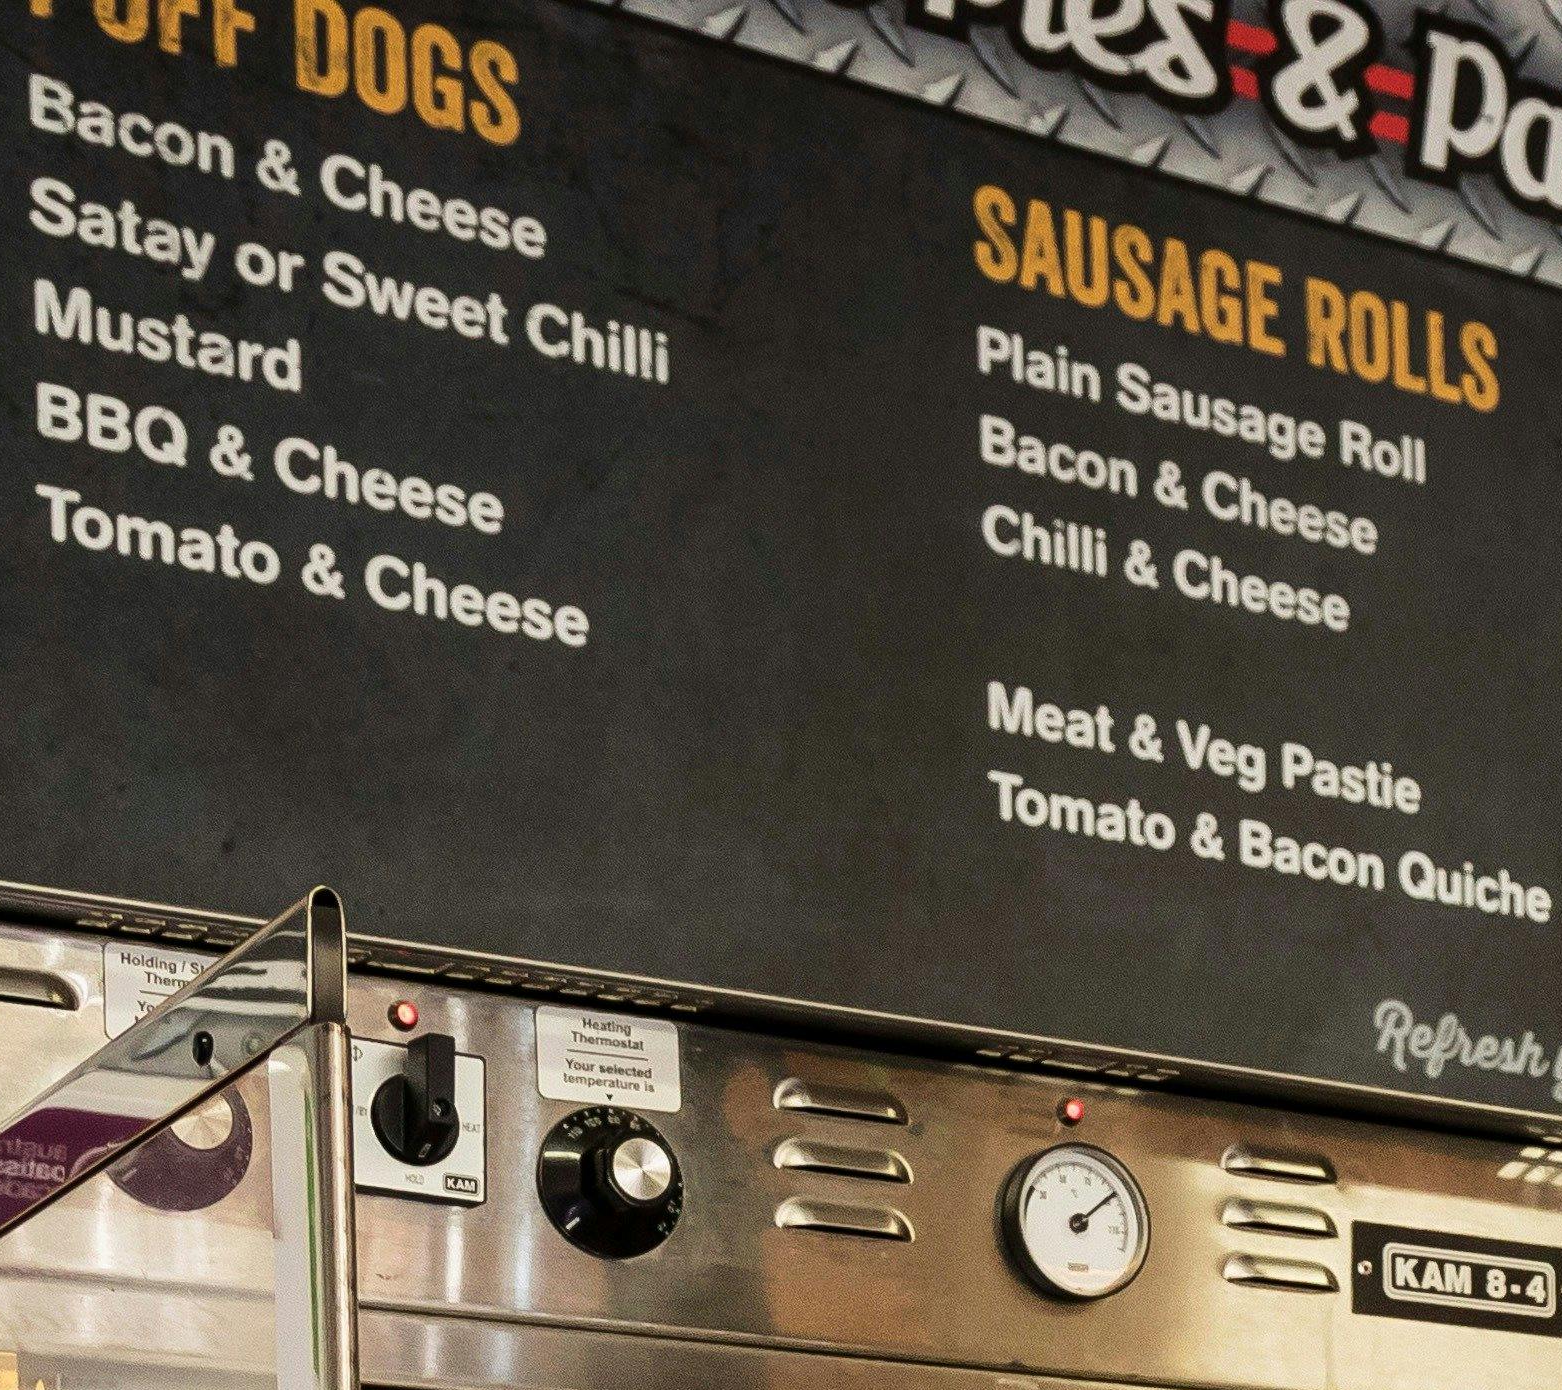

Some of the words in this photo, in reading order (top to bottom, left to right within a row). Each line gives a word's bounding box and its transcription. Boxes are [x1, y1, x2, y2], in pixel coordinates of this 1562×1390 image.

[295, 0, 522, 147] DOGS
[1270, 0, 1370, 142] &
[28, 73, 236, 179] Bacon
[255, 139, 301, 197] &
[319, 154, 547, 259] Cheese
[28, 176, 215, 279] Satay
[235, 240, 305, 292] or
[321, 250, 509, 346] Sweet
[525, 303, 670, 384] Chilli
[33, 279, 302, 393] Mustard
[972, 184, 1287, 359] SAUSAGE
[1304, 276, 1500, 414] ROLLS
[36, 381, 189, 468] BBQ
[209, 424, 255, 481] &
[273, 436, 505, 535] Cheese
[976, 324, 1102, 403] Plain
[1115, 360, 1327, 461] Sausage
[1338, 419, 1428, 486] Roll
[980, 413, 1138, 499] Bacon
[1152, 460, 1189, 509] &
[1201, 469, 1379, 556] Cheese
[35, 484, 282, 585] Tomato
[300, 543, 347, 600] &
[364, 554, 590, 648] Cheese
[980, 504, 1109, 578] Chilli
[1124, 538, 1160, 590] &
[1172, 548, 1352, 632] Cheese
[987, 680, 1115, 753] Meat
[1129, 713, 1164, 763] &
[1175, 718, 1267, 794] Veg
[1280, 740, 1423, 815] Pastie
[988, 769, 1177, 851] Tomato
[1190, 812, 1226, 862] &
[1238, 818, 1386, 893] Bacon
[1398, 850, 1553, 924] Quiche
[120, 951, 178, 975] Holding
[582, 1016, 632, 1037] Heating
[563, 1072, 640, 1093] temperature
[644, 1080, 655, 1093] is
[564, 1057, 595, 1073] Your
[598, 1062, 653, 1080] selected
[571, 1029, 644, 1051] Thermostat
[1373, 998, 1550, 1080] Refresh
[446, 1176, 476, 1193] KAM
[1394, 1256, 1473, 1296] KAM
